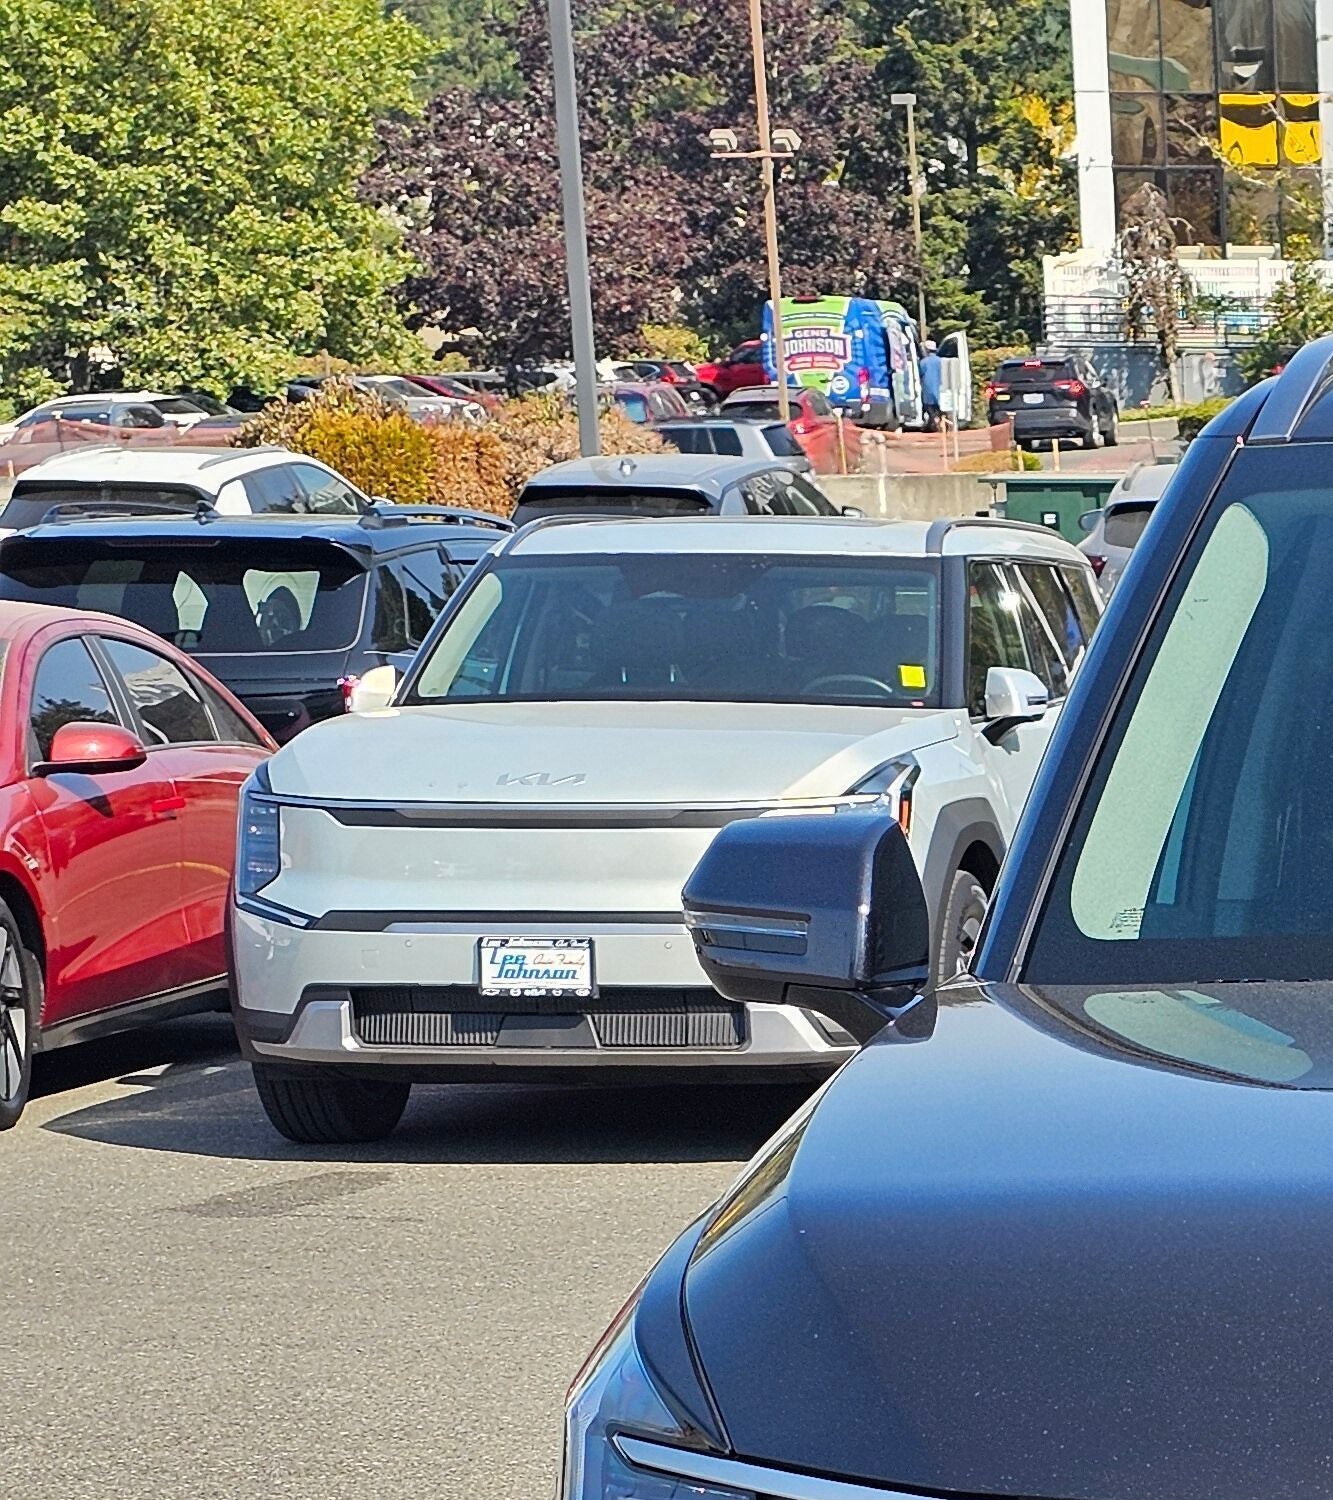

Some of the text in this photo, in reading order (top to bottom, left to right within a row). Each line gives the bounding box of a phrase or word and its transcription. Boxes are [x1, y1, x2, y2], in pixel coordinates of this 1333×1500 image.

[794, 329, 829, 338] GENE
[783, 338, 845, 358] JOHNSON
[489, 947, 528, 965] Lee
[491, 960, 580, 980] Johnson
